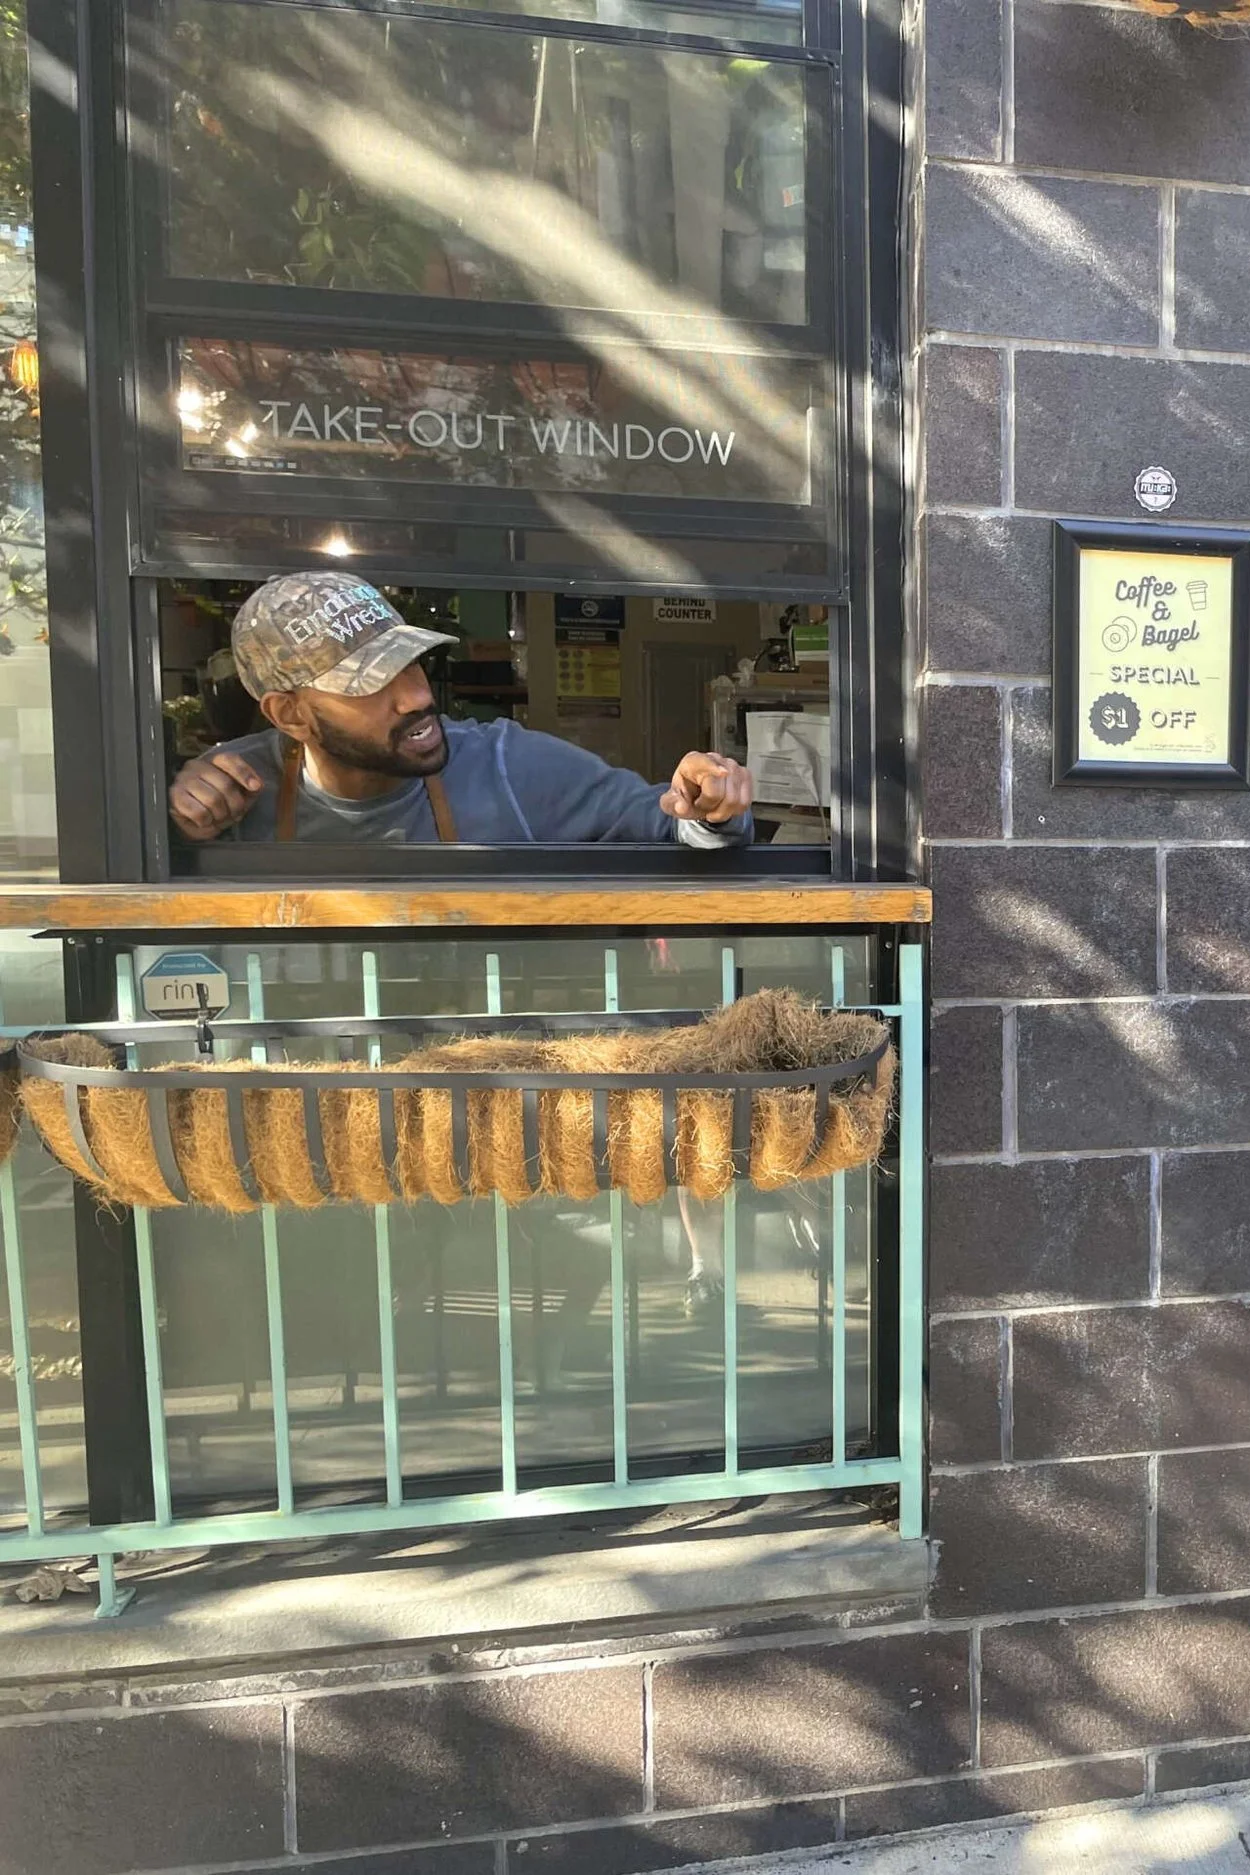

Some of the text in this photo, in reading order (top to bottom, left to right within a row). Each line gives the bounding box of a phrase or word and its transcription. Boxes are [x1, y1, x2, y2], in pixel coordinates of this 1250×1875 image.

[259, 400, 735, 466] TAKE-OUT WINDOW
[1115, 576, 1177, 608] Coffee
[658, 607, 712, 620] COUNTER
[1152, 601, 1171, 621] &
[1141, 620, 1200, 651] Bagel
[1109, 665, 1200, 686] SPECIAL
[1101, 705, 1197, 730] $1 OFF
